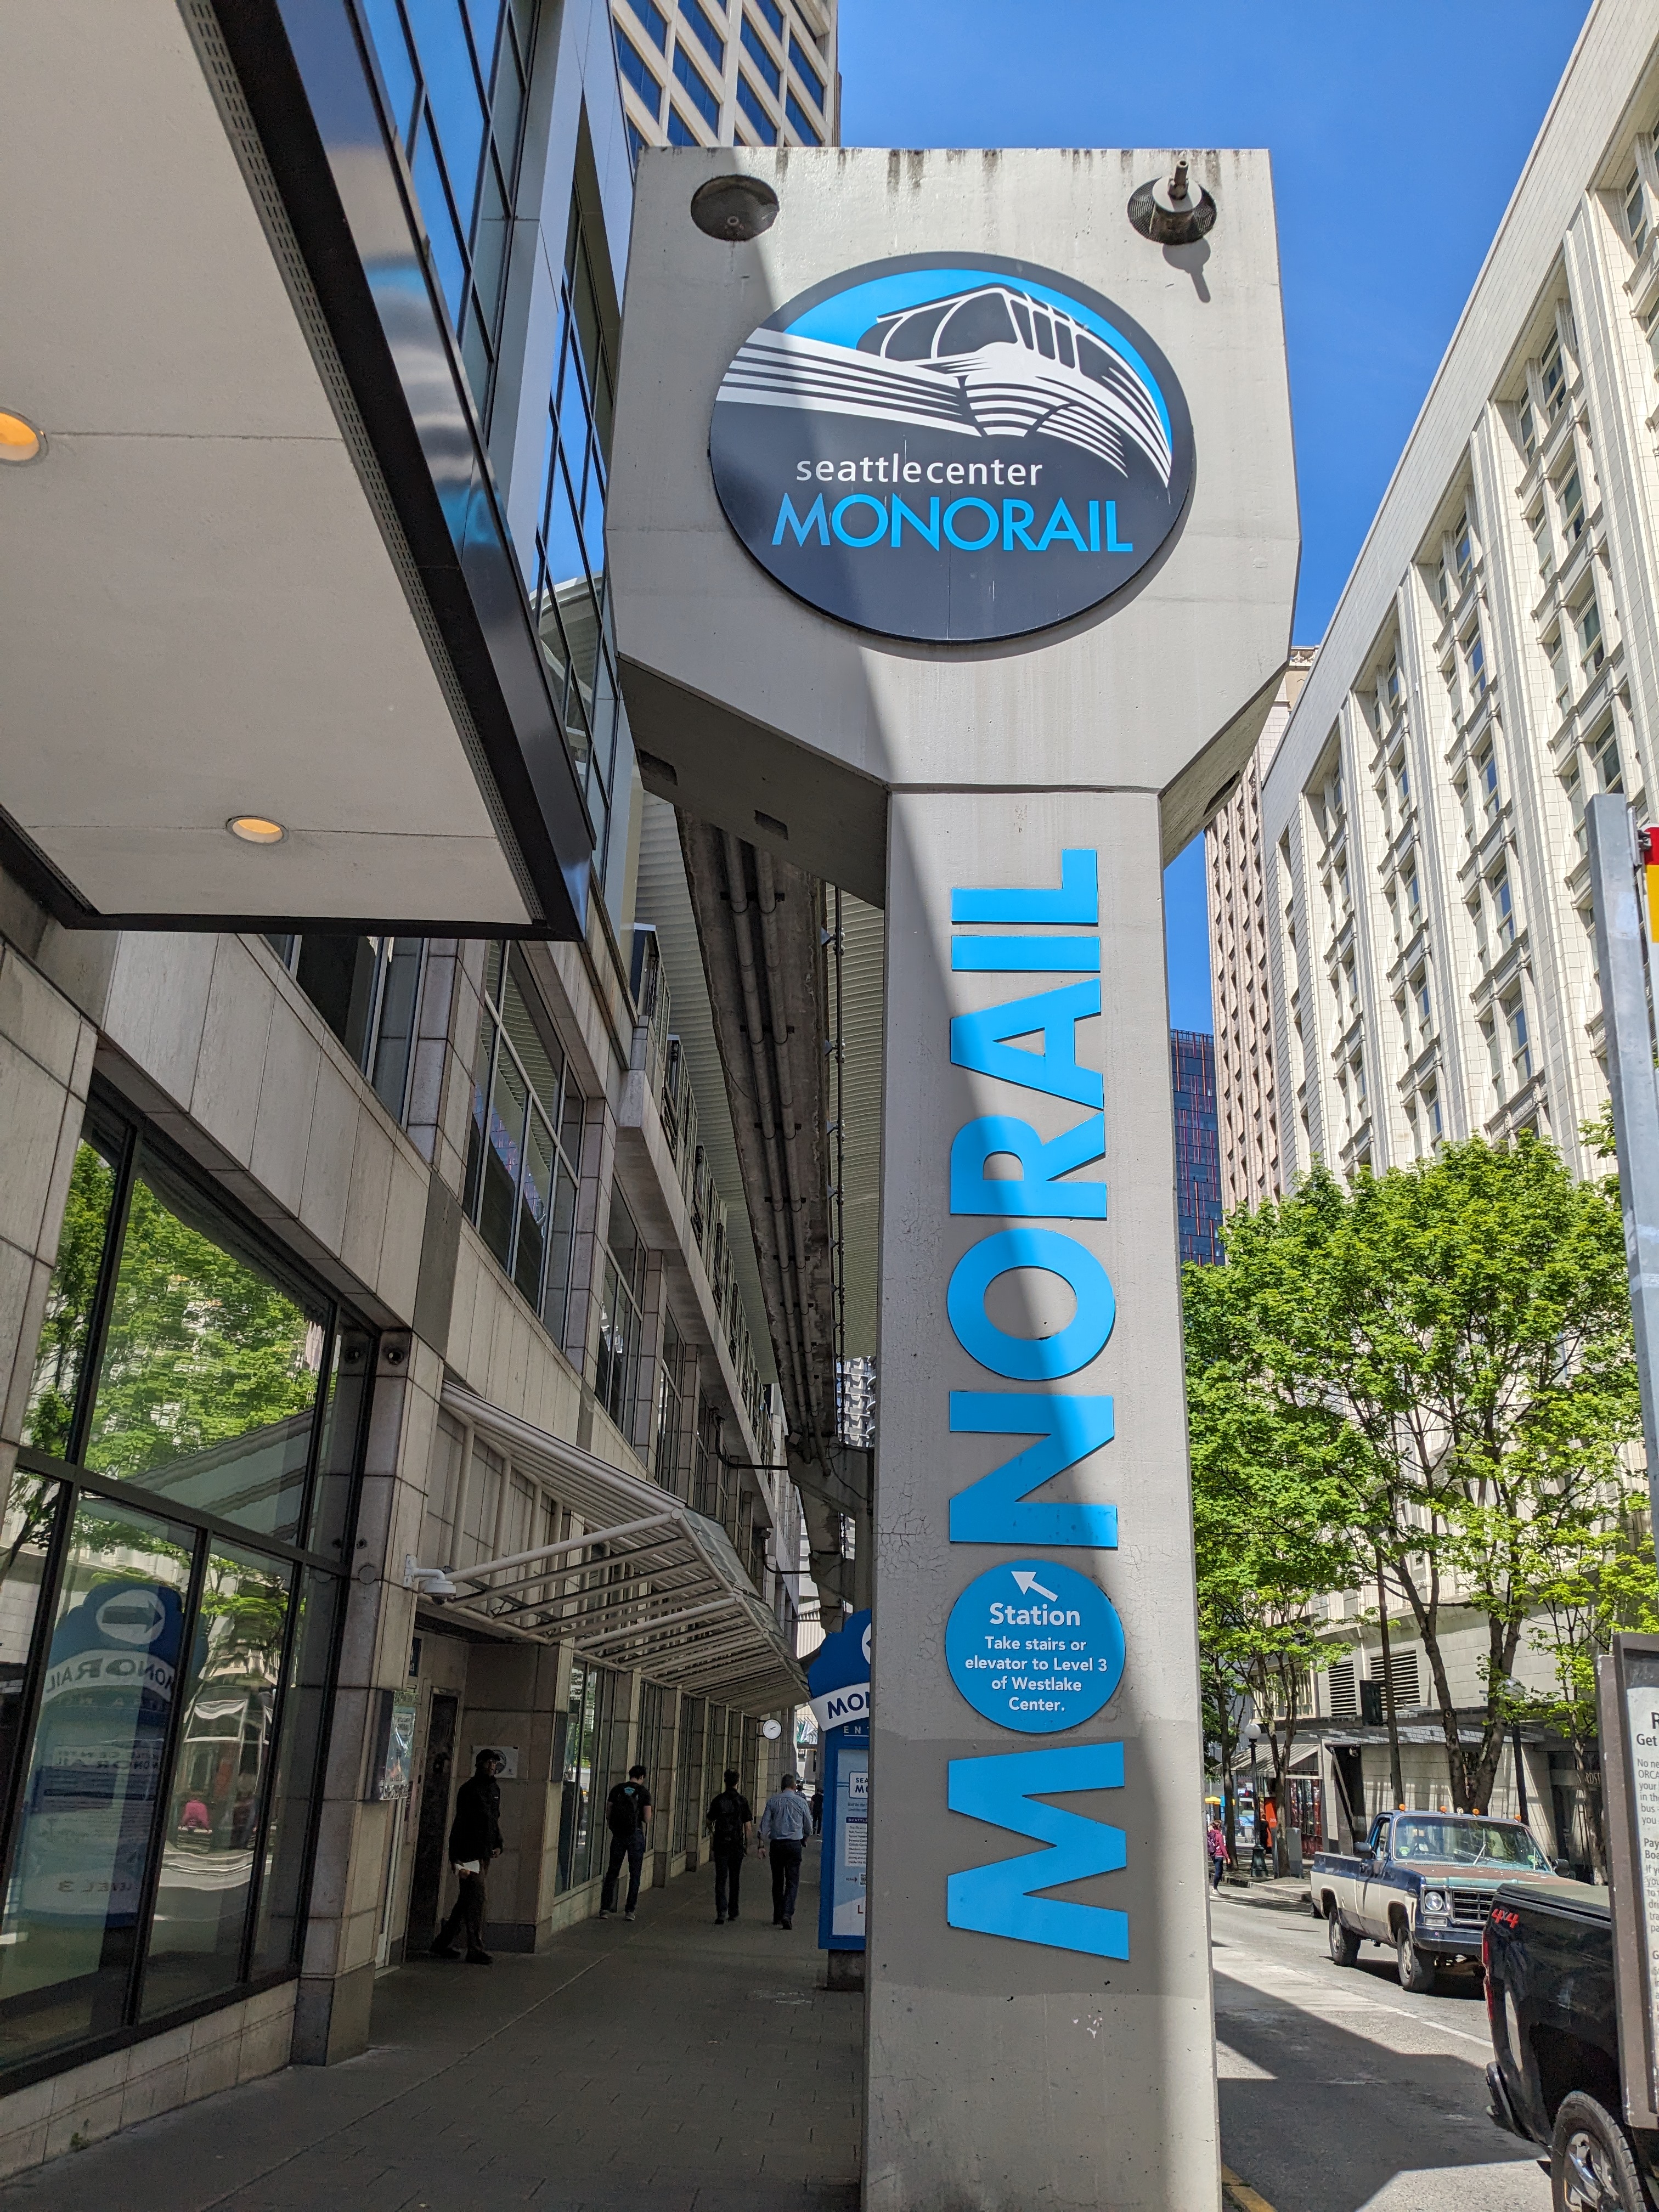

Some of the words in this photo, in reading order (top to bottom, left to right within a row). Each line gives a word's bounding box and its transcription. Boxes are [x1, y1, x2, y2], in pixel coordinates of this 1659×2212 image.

[771, 493, 1133, 552] MONORAIL
[990, 1602, 1080, 1626] Station
[985, 1636, 1020, 1650] Take
[1025, 1637, 1066, 1651] stairs
[1070, 1640, 1087, 1651] or
[965, 1655, 1028, 1670] elevator
[1032, 1658, 1048, 1671] to
[1054, 1657, 1093, 1672] Level
[1098, 1658, 1108, 1672] 3
[991, 1676, 1008, 1690] of
[1012, 1677, 1082, 1691] Westlake
[827, 1691, 870, 1719] MO
[1008, 1697, 1065, 1711] Center.
[844, 1726, 869, 1734] EN
[1637, 1734, 1658, 1746] Get
[1638, 1758, 1649, 1767] No
[1639, 1783, 1656, 1792] your
[1640, 1792, 1647, 1801] in
[1641, 1803, 1655, 1813] bus
[1642, 1817, 1656, 1826] you
[1644, 1838, 1659, 1850] Pay
